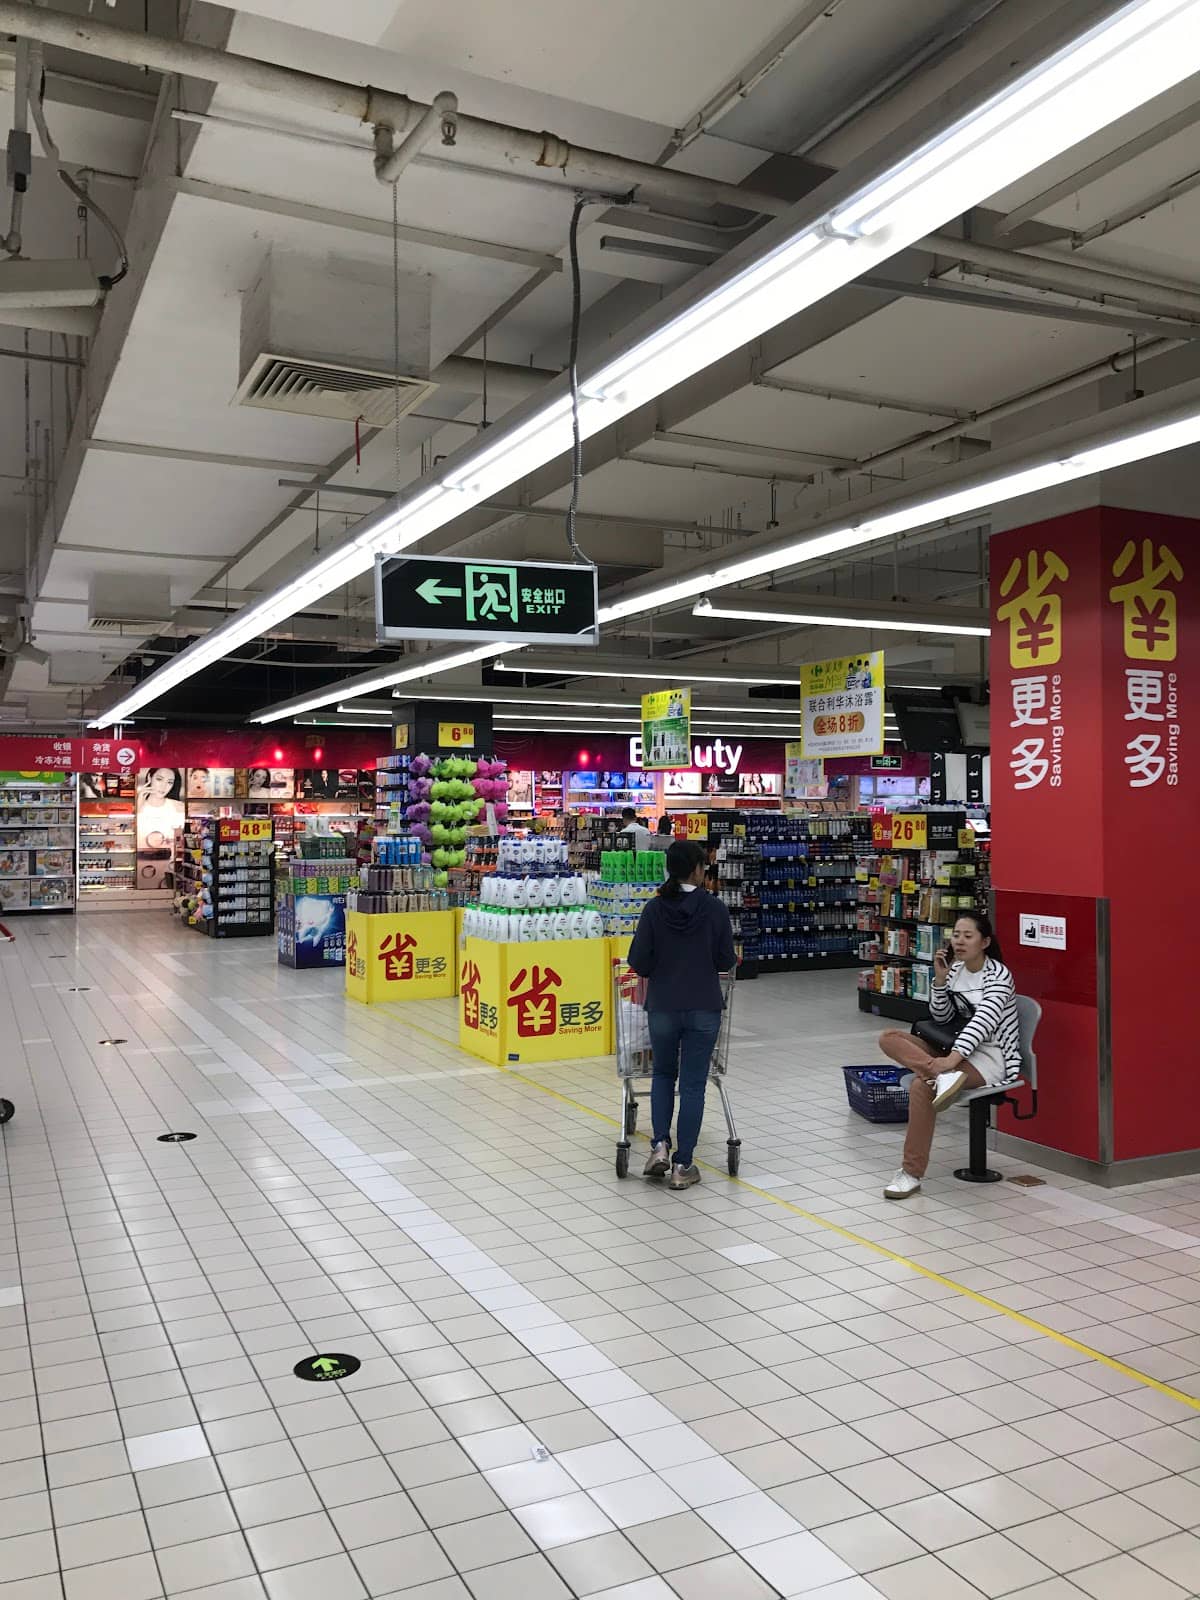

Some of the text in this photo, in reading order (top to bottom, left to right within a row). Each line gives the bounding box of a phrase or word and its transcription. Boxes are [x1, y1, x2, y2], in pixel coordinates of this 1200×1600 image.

[521, 588, 565, 604] 安全出口
[526, 605, 561, 615] EXIT
[817, 714, 859, 734] 全场8折
[1050, 674, 1064, 787] Saving More
[1166, 672, 1180, 786] Saving More
[92, 757, 110, 766] 生鲜
[629, 736, 743, 775] Buty
[242, 823, 260, 836] 48
[688, 818, 700, 834] 92
[894, 820, 913, 840] 26
[559, 1025, 602, 1035] Saving More
